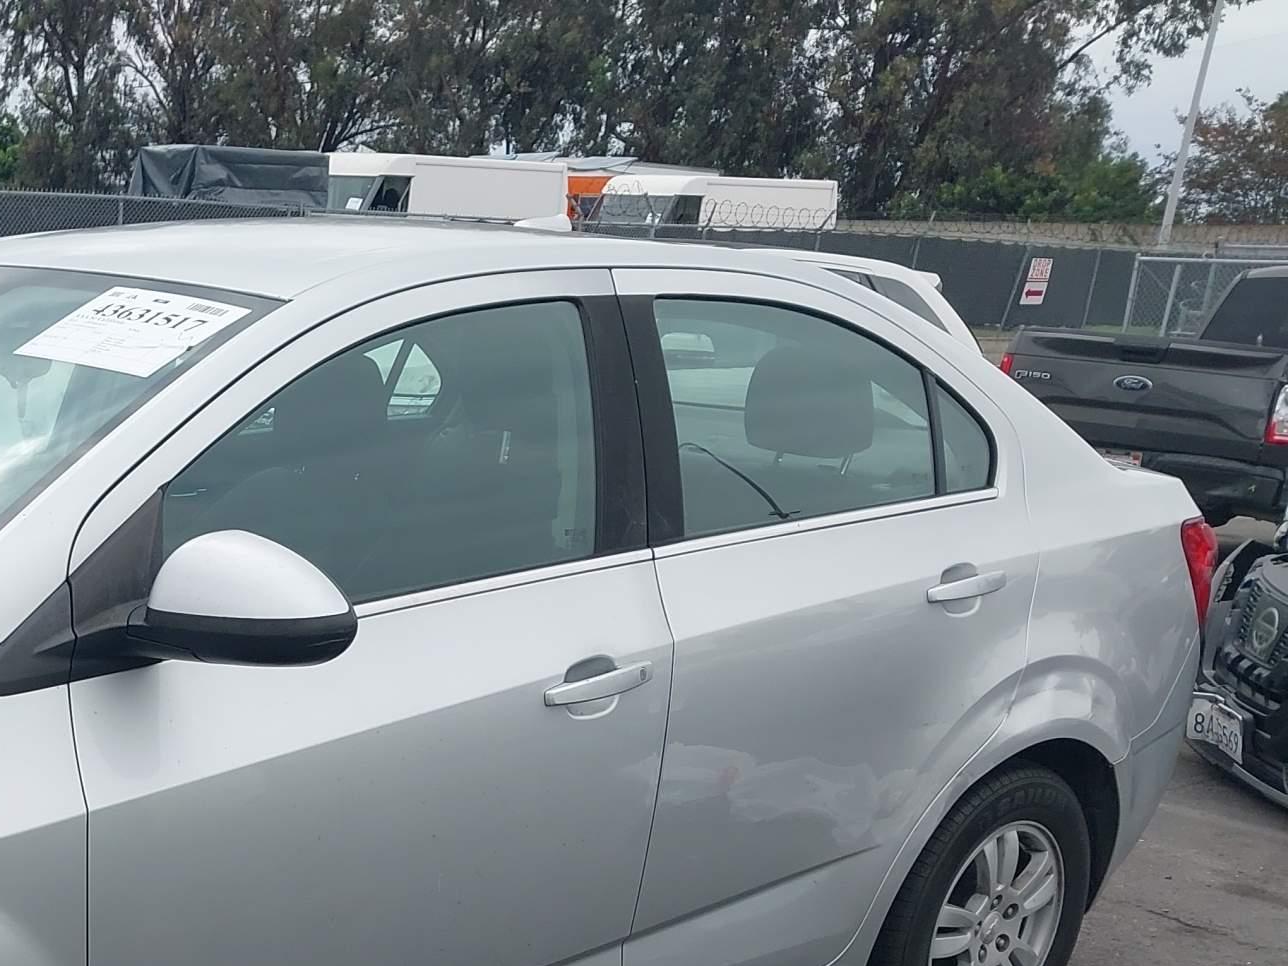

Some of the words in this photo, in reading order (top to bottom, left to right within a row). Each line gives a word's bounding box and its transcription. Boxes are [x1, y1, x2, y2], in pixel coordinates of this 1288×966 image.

[1032, 258, 1052, 267] DROP
[1030, 267, 1049, 278] ZONE
[91, 303, 209, 332] 43631517
